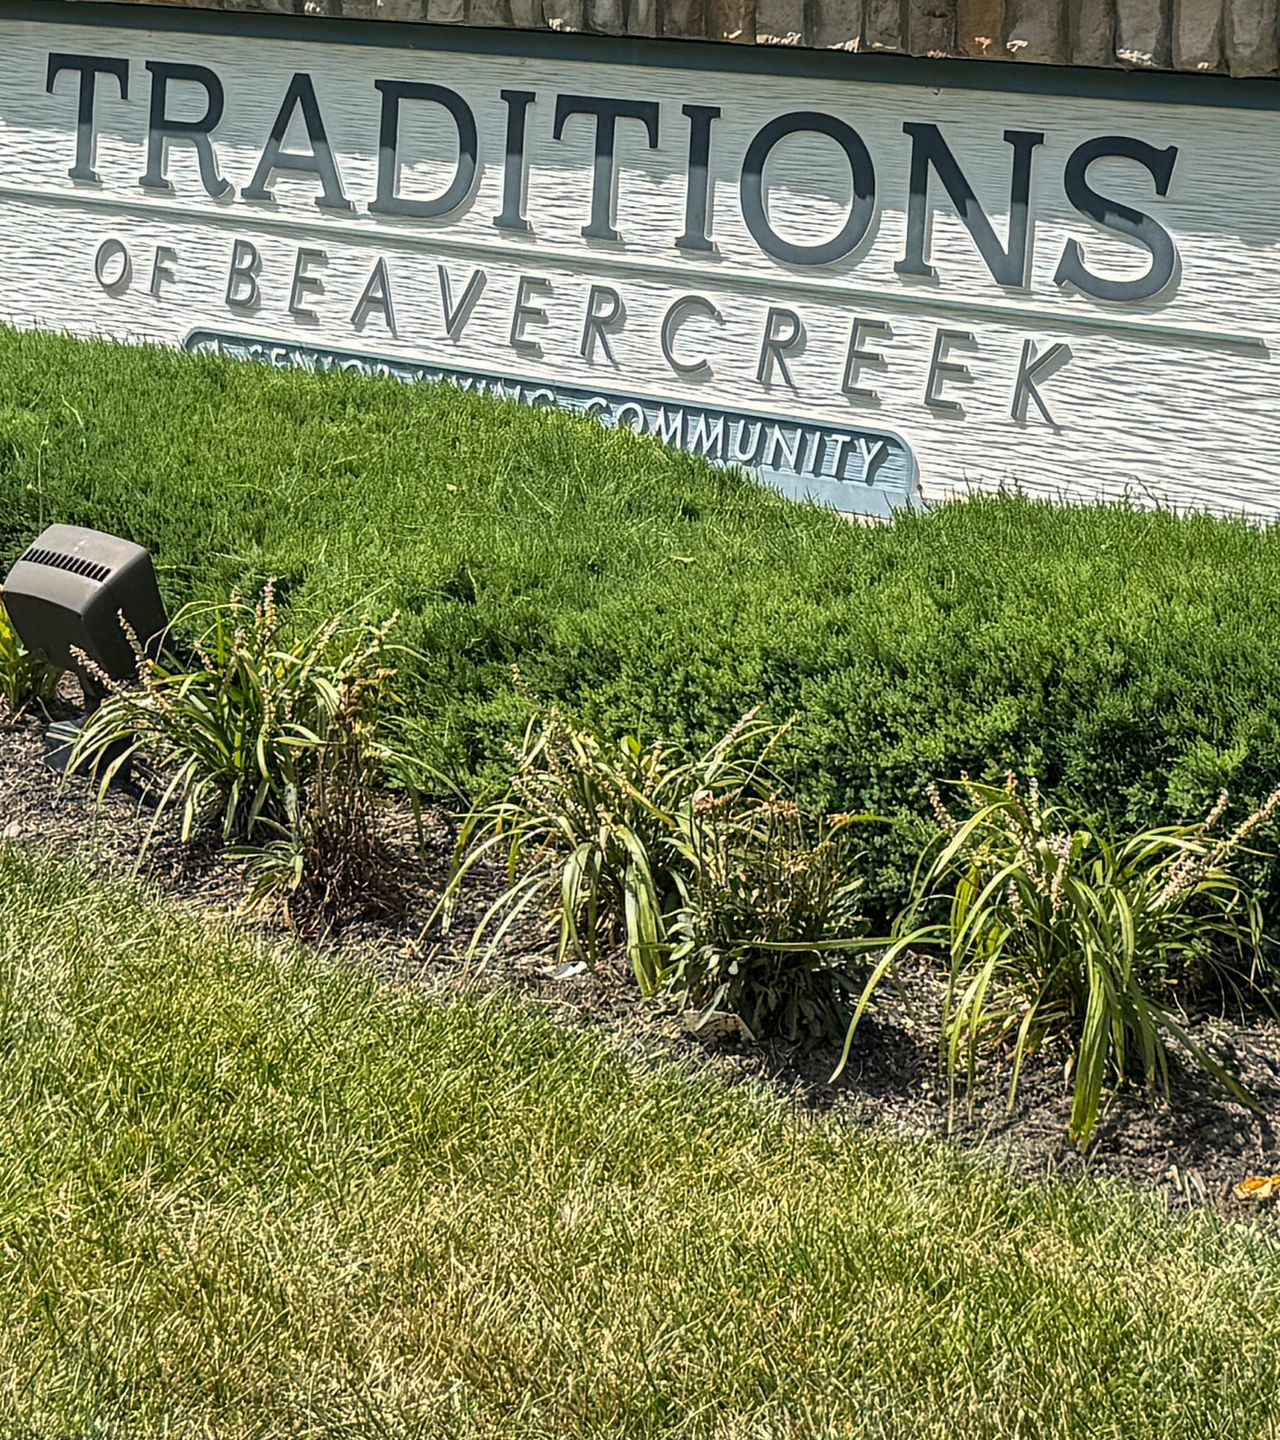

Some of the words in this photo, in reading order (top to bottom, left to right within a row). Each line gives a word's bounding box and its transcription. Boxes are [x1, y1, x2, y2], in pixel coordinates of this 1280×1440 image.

[45, 52, 1180, 303] TRADITIONS
[94, 237, 177, 297] OF
[225, 238, 1072, 429] BEAVERCREEK
